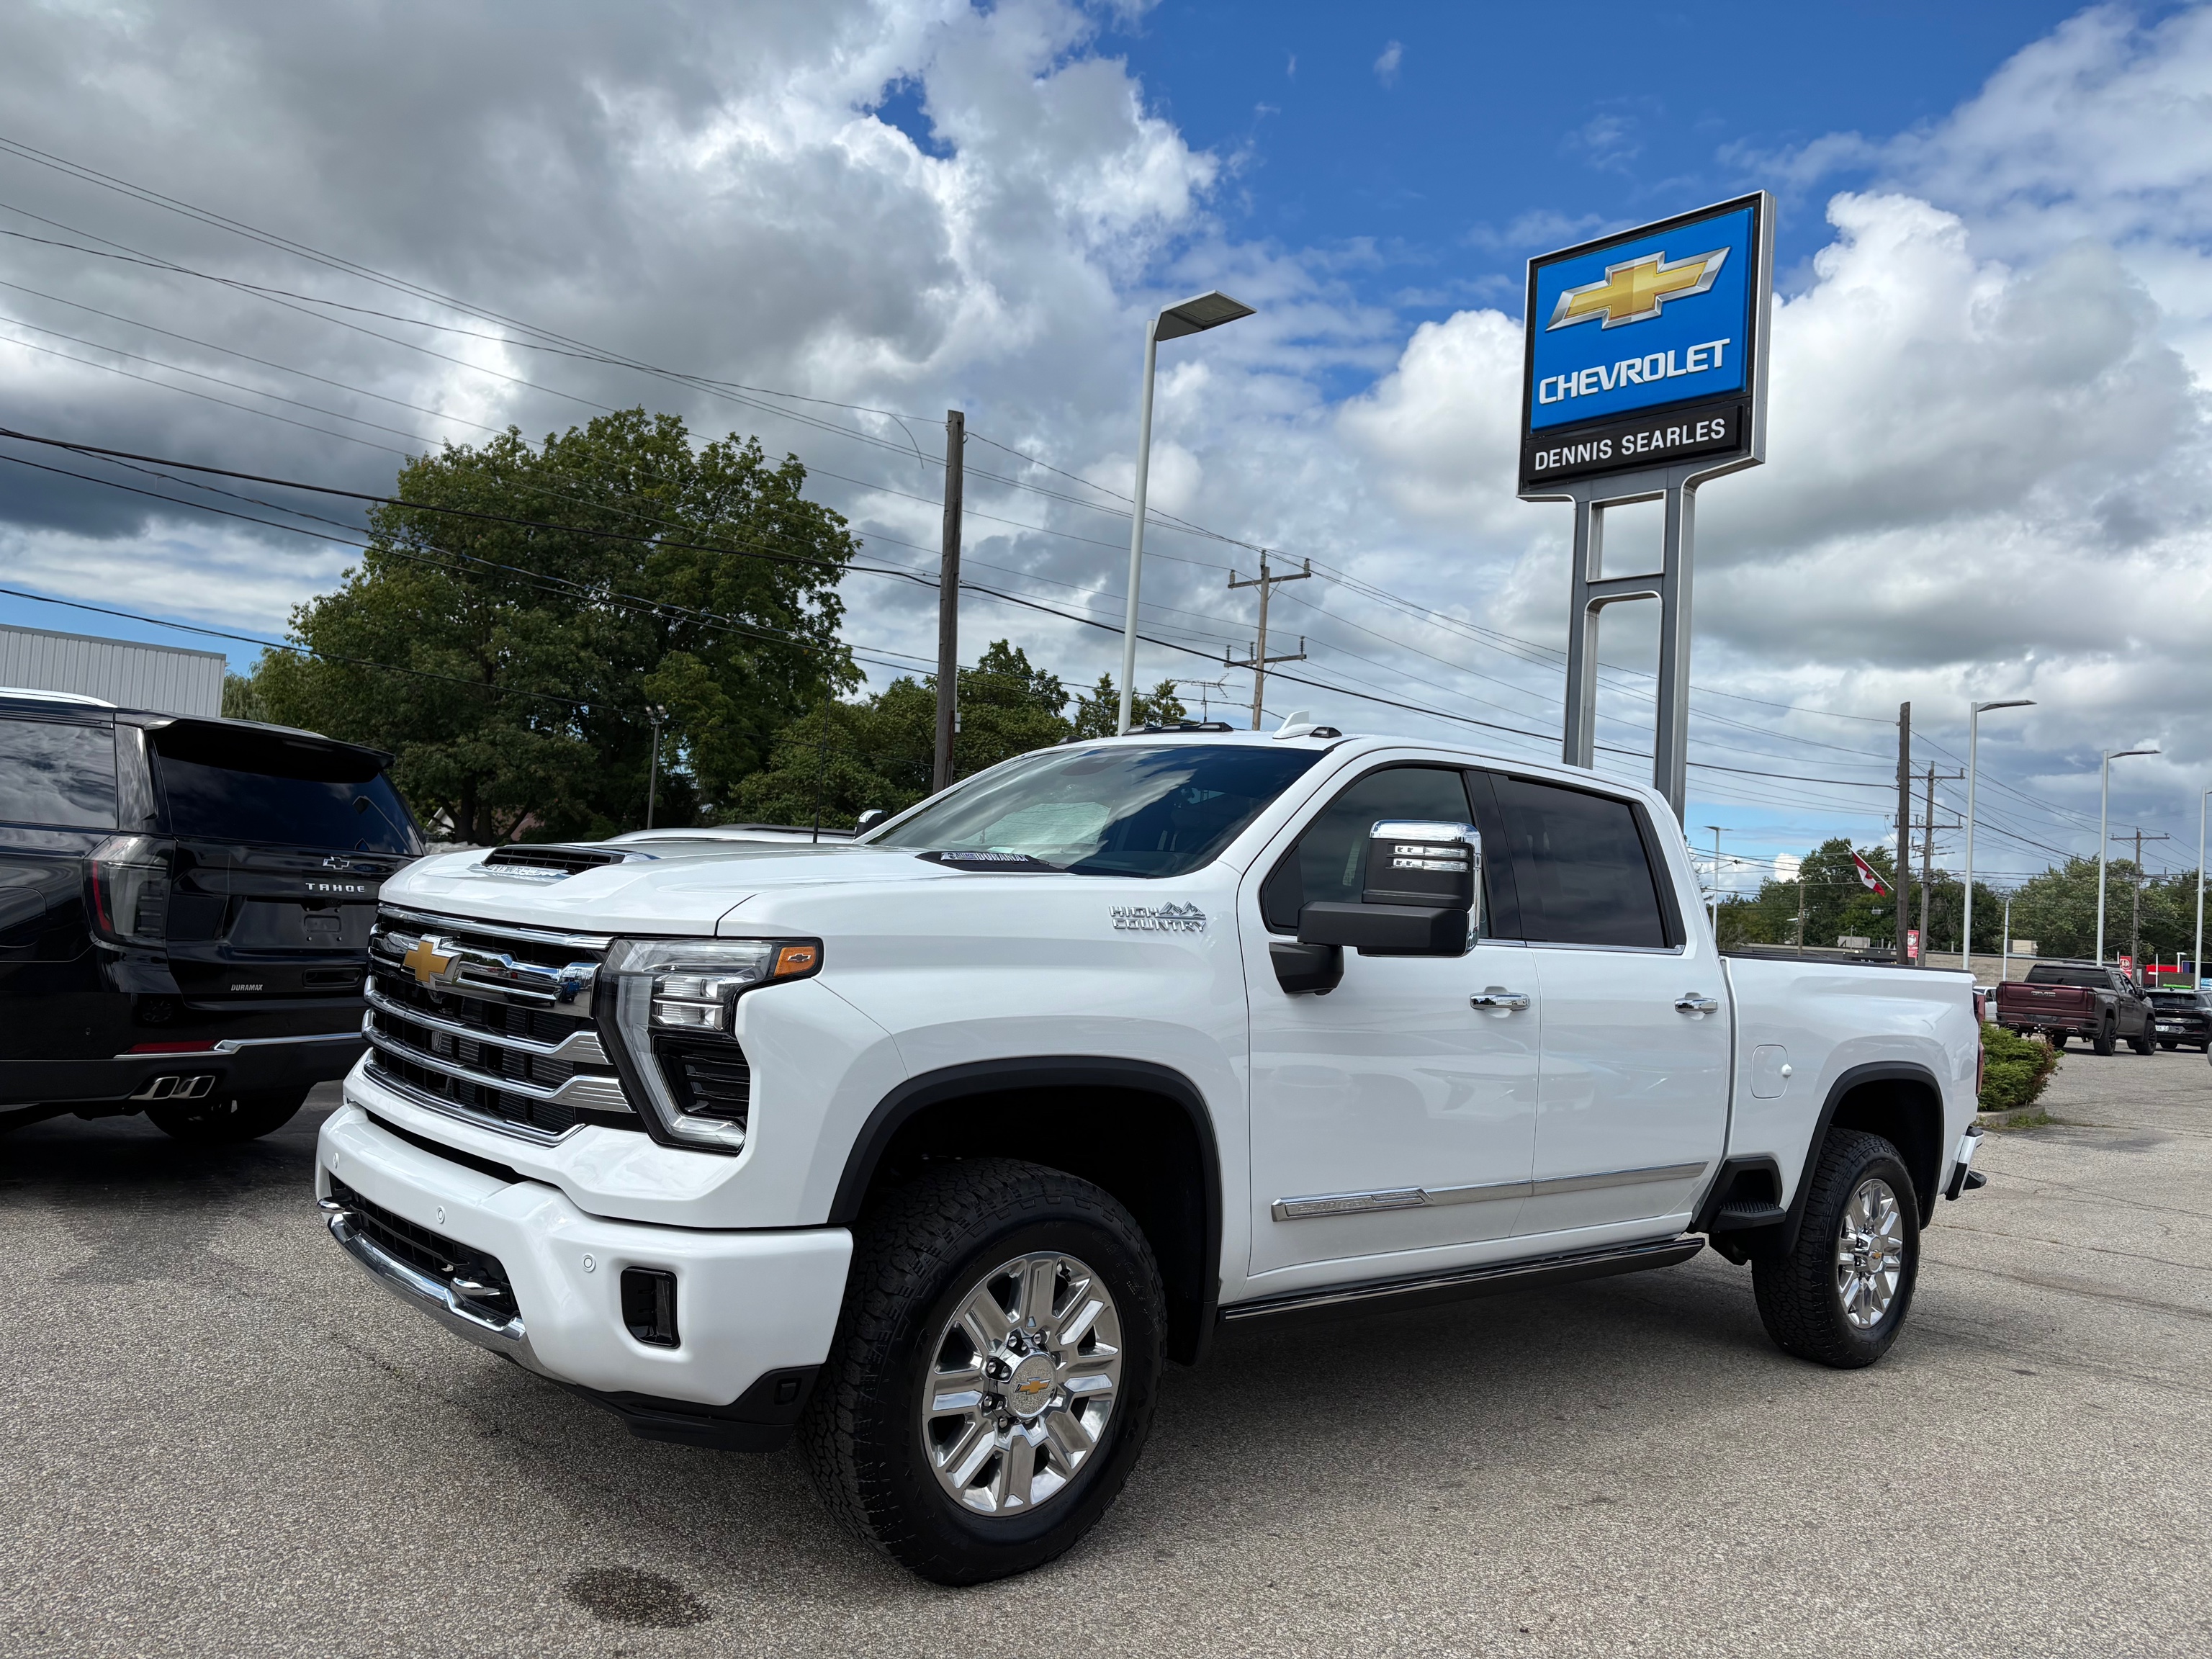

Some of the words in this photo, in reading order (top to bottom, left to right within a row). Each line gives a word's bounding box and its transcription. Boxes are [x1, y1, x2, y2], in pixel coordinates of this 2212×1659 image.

[1539, 338, 1730, 405] CHEVROLET
[1534, 439, 1612, 470] DENNIS
[1621, 418, 1725, 455] SEARLES
[976, 853, 1029, 862] DURAMAX
[305, 883, 365, 893] TAHOE
[1109, 906, 1159, 918] HIGH
[1112, 918, 1207, 932] COUNTRY
